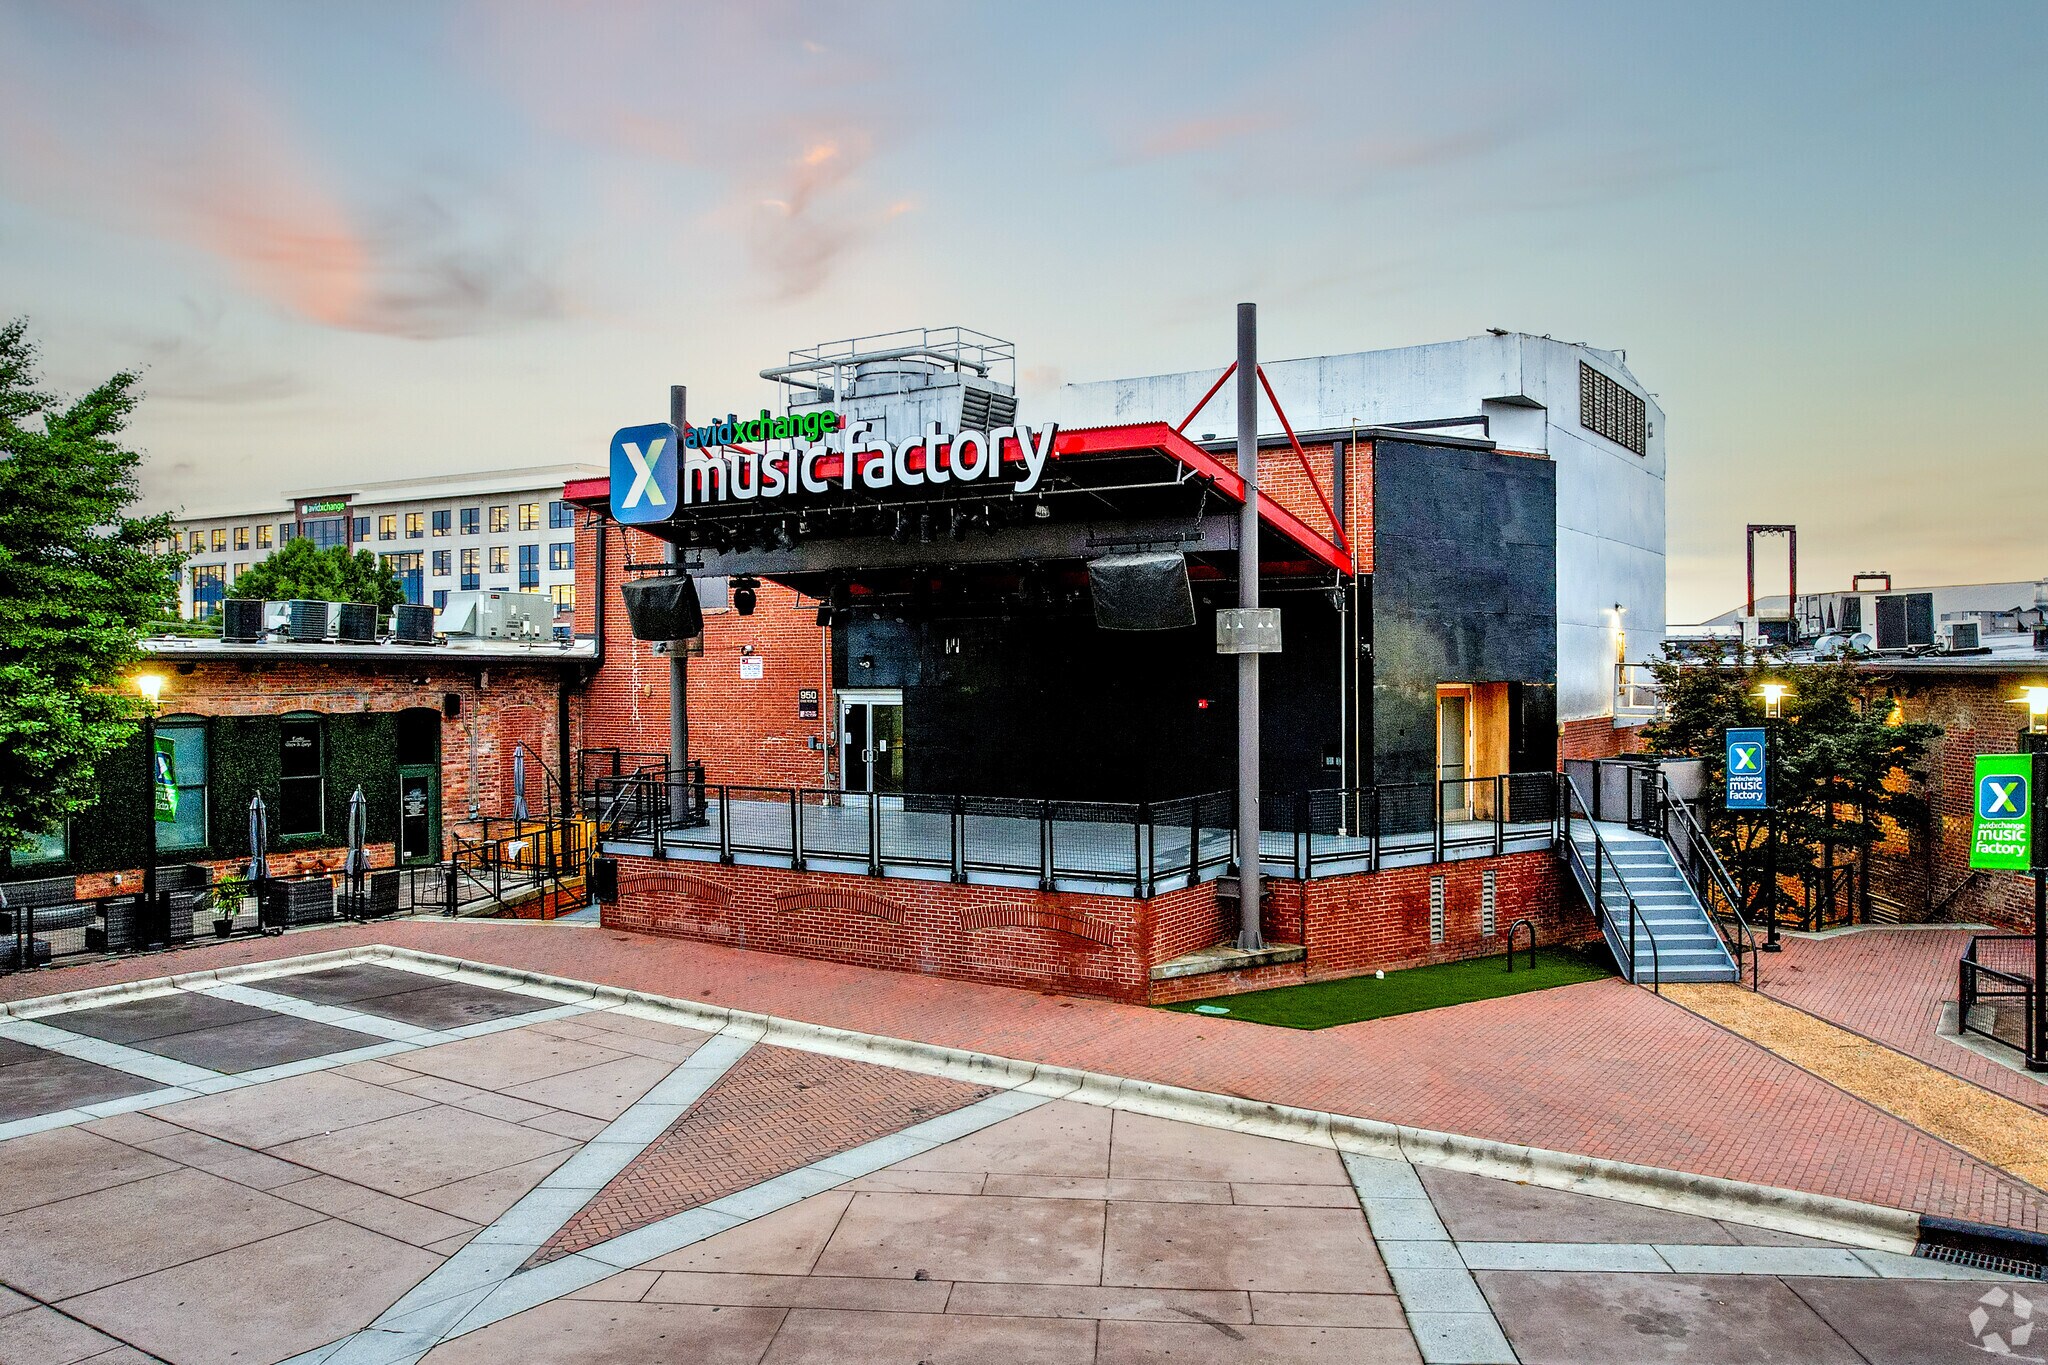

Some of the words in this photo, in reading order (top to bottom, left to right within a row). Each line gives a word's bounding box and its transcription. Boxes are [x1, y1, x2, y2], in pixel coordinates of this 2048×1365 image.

[685, 409, 837, 449] avidxchange
[683, 446, 830, 504] music
[842, 420, 1059, 492] factory
[800, 690, 817, 699] 950
[1729, 781, 1763, 790] music
[1729, 790, 1763, 801] factory
[1978, 822, 2025, 830] avidxchange
[1977, 829, 2026, 841] music
[1975, 840, 2026, 857] factory
